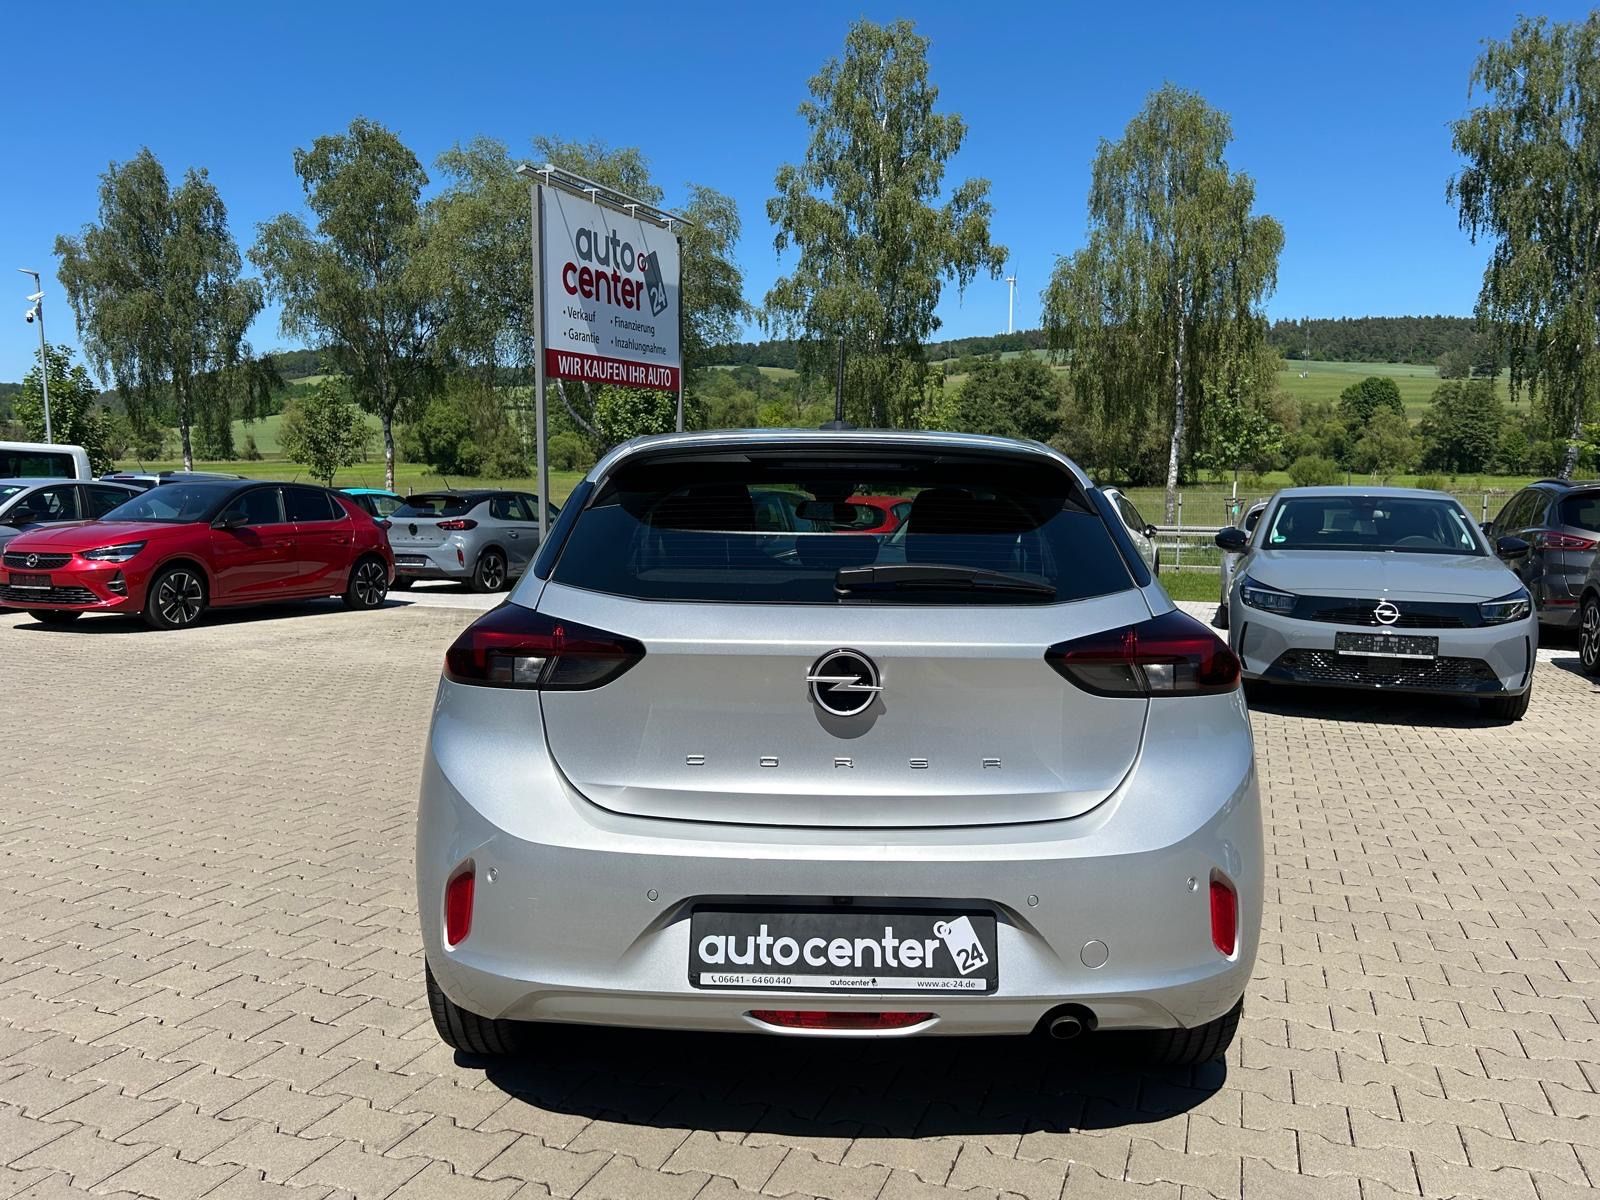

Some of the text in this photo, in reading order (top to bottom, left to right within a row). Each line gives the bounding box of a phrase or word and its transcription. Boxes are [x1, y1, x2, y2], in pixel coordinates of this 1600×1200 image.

[576, 227, 635, 273] auto
[562, 261, 644, 311] center
[650, 284, 667, 310] 24
[568, 306, 596, 323] Verkauf
[614, 316, 655, 336] Finanzierung
[568, 328, 600, 345] Garantie
[615, 336, 666, 356] Inzahlungnahme
[558, 355, 671, 387] WIR KAUFEN IHR AUTO
[686, 754, 1002, 769] CORSA
[956, 942, 984, 971] 24
[718, 975, 744, 984] 06641
[829, 978, 870, 987] autocenter
[917, 980, 976, 990] www.ac-24.de
